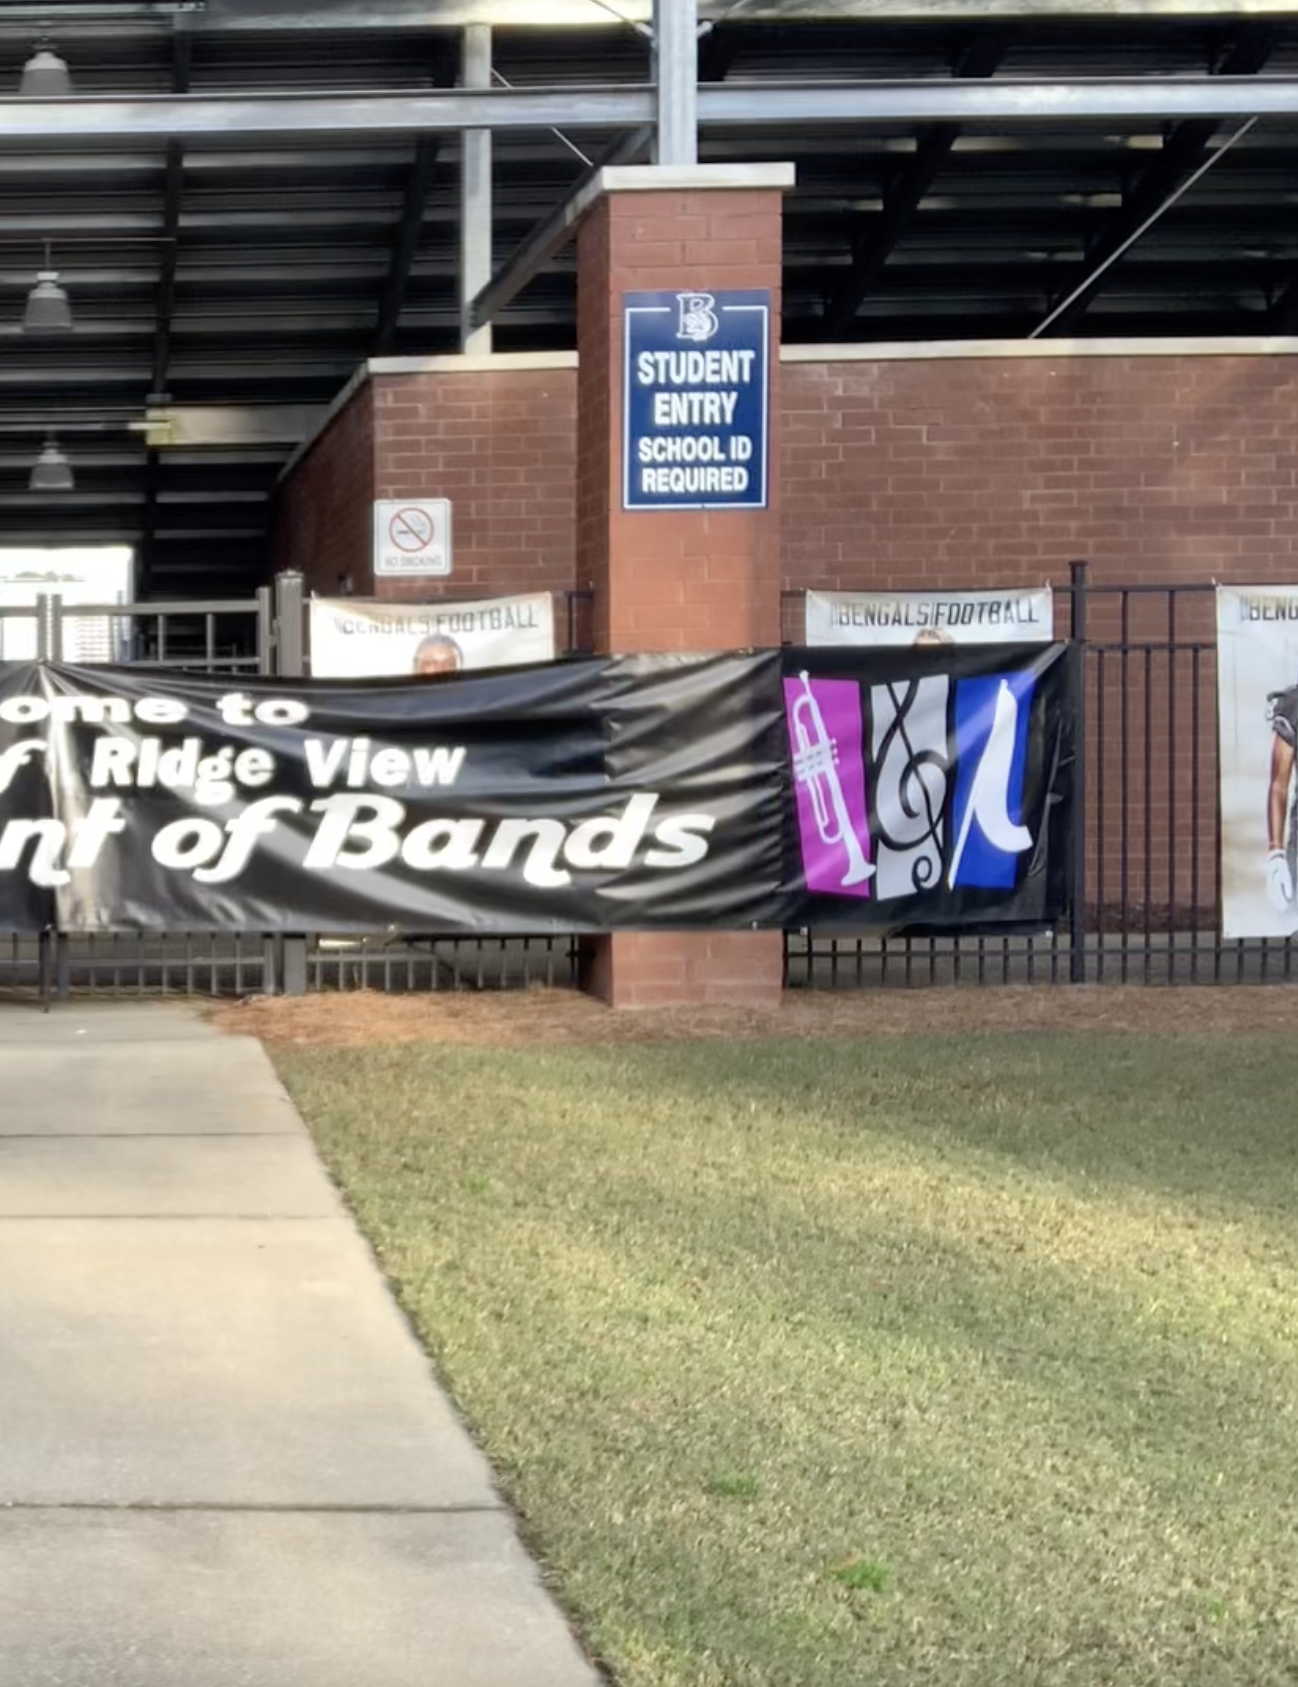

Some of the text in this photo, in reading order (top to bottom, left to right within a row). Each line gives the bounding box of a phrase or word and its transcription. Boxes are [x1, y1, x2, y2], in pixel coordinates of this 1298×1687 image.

[637, 350, 755, 385] STUDENT
[654, 391, 738, 426] ENTRY
[638, 436, 752, 463] SCHOOL ID
[641, 467, 748, 494] REQUIRED
[436, 604, 538, 634] FOOTBALL
[838, 597, 1039, 628] BENGALS FOOTBALL
[216, 692, 310, 727] to
[303, 736, 467, 788] View
[151, 795, 303, 884] of
[303, 792, 716, 887] Bands
